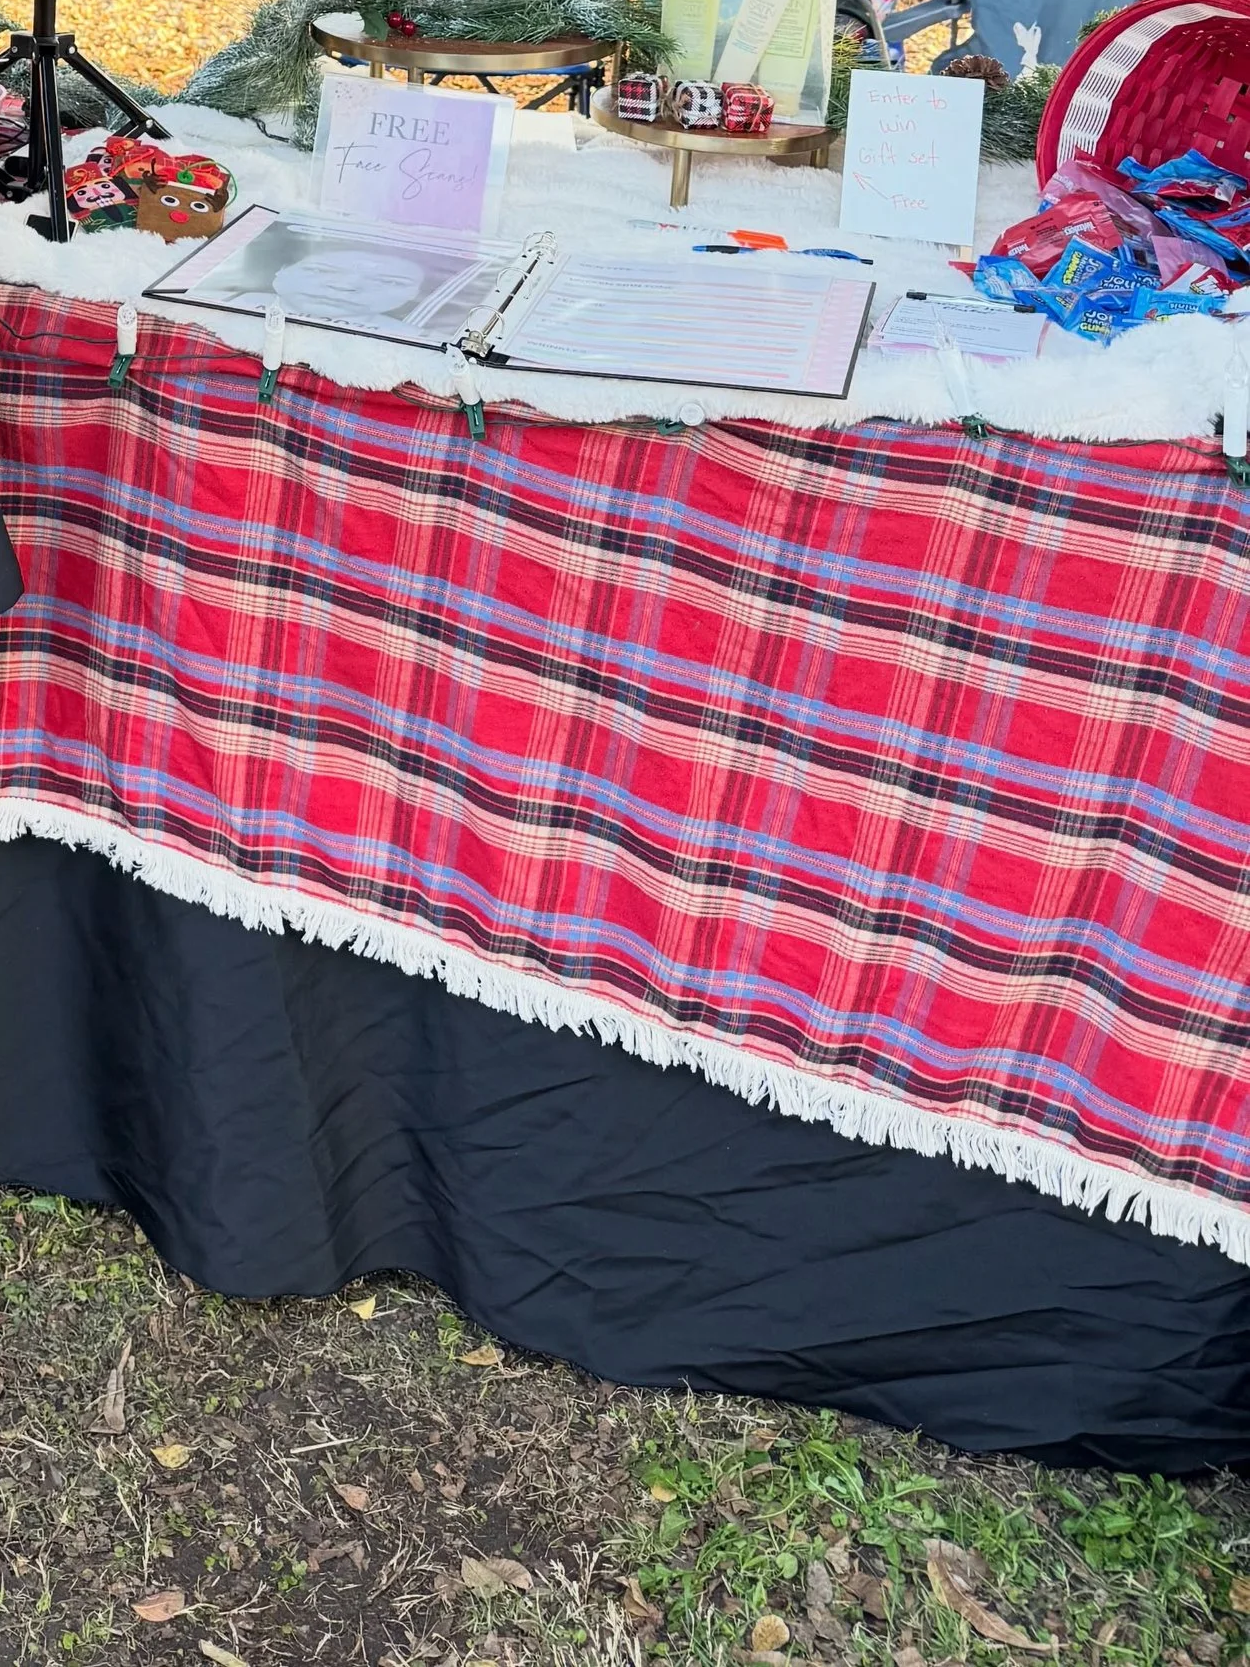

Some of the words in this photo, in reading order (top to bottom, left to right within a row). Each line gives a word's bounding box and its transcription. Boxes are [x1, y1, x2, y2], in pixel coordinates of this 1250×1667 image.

[868, 86, 919, 106] Enter
[927, 89, 948, 110] to
[368, 112, 450, 146] FREE
[333, 142, 388, 184] Free
[858, 141, 897, 166] Gift
[890, 194, 929, 211] Free
